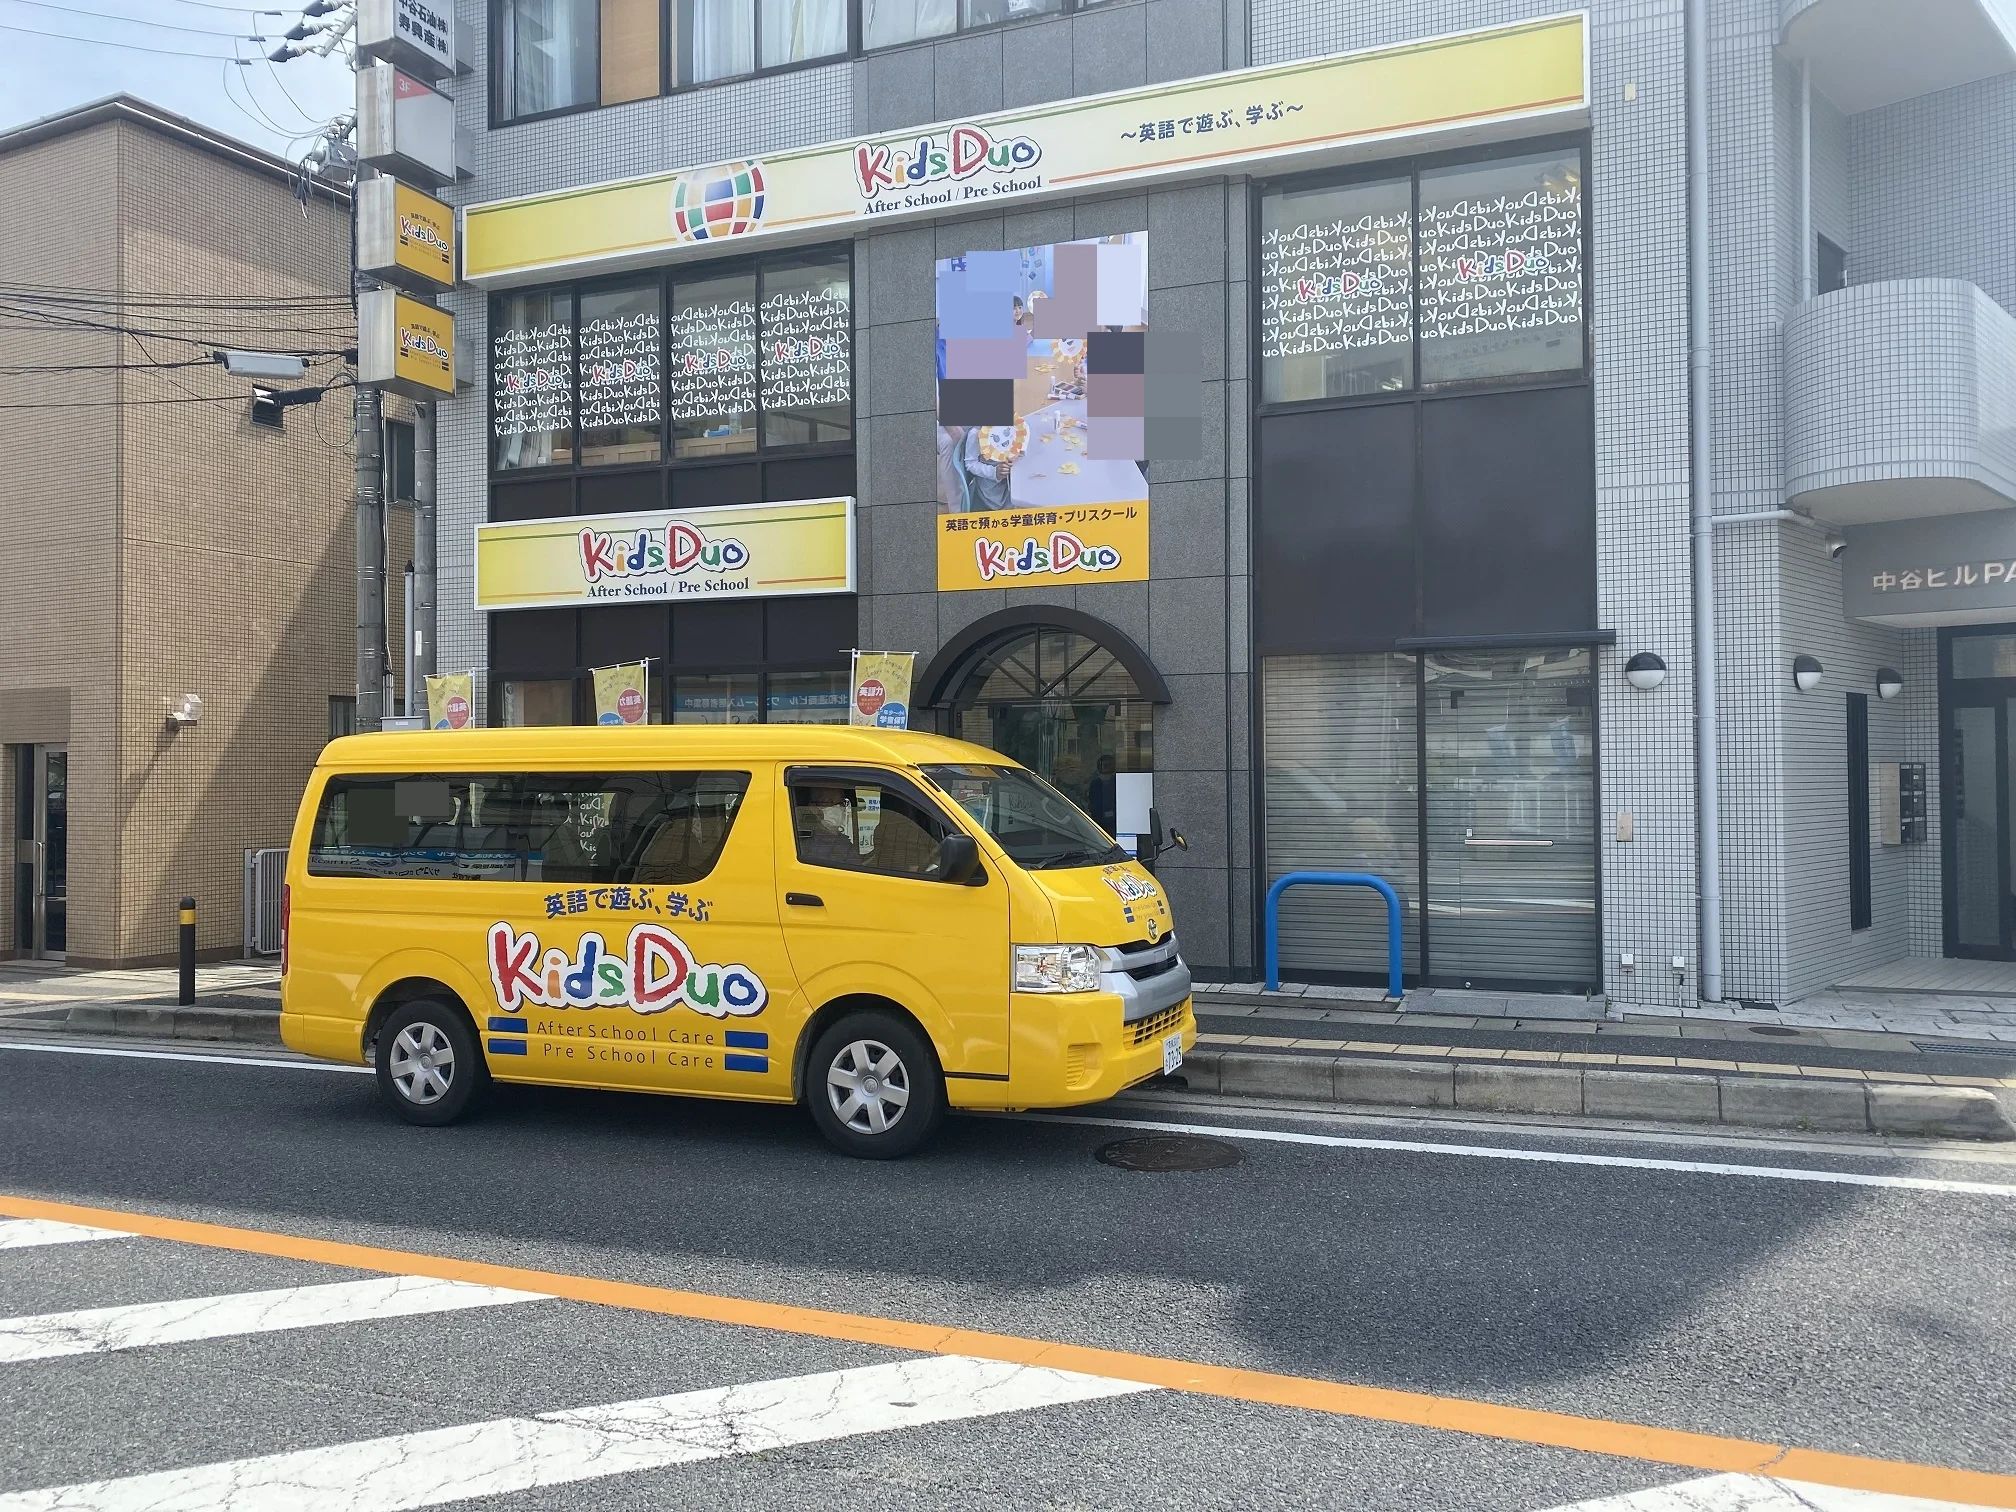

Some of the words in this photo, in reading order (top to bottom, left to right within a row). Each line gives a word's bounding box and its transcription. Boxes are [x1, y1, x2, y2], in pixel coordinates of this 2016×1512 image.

[855, 125, 1039, 195] KidsDuo
[864, 199, 901, 214] After
[905, 190, 951, 208] School
[964, 186, 988, 199] Pre
[992, 176, 1042, 194] School
[401, 216, 448, 250] KidsDuo
[1457, 250, 1549, 279] KidsDuo
[1298, 271, 1382, 300] KidsDuo
[401, 327, 448, 359] KidsDuo
[775, 337, 839, 361] KidsDuo
[592, 360, 651, 383] KidsDuo
[685, 349, 746, 370] KidsDuo
[507, 369, 563, 391] KidsDuo
[580, 523, 746, 580] KidsDuo
[977, 533, 1119, 578] KidsDuo
[587, 585, 621, 598] After
[624, 582, 668, 596] School
[678, 580, 701, 593] Pre
[704, 577, 749, 592] School
[544, 886, 713, 922] 英語で遊ぶ、学ぶ
[490, 924, 765, 1013] KidsDuo
[669, 1029, 714, 1046] Care
[544, 1043, 574, 1058] Pre
[588, 1046, 655, 1065] School
[668, 1053, 713, 1069] Care
